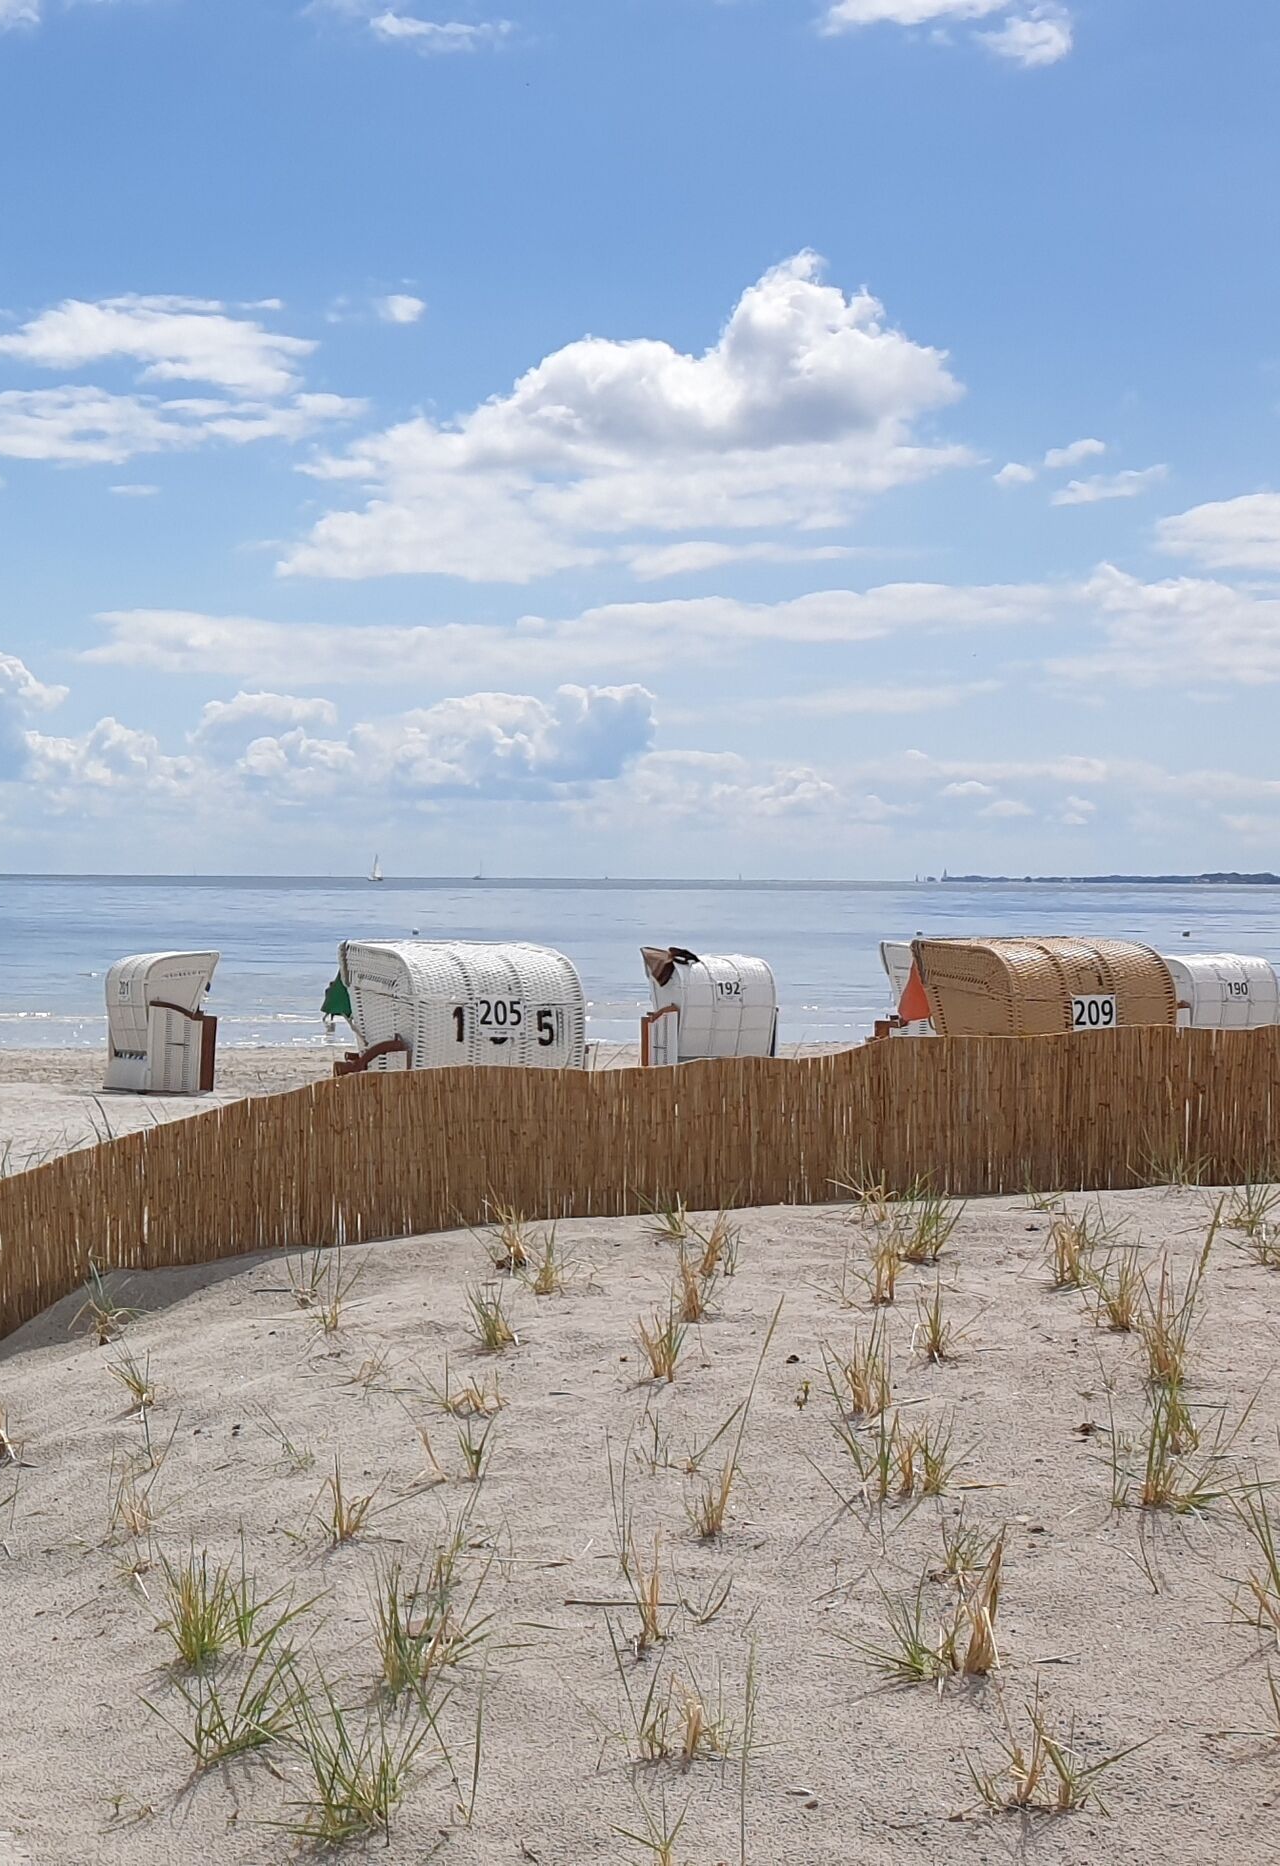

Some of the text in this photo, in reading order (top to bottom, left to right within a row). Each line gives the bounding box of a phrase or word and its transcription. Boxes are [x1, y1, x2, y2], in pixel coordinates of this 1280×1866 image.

[718, 981, 741, 996] 192
[1227, 982, 1248, 996] 190
[479, 999, 522, 1026] 205
[1073, 999, 1114, 1026] 209
